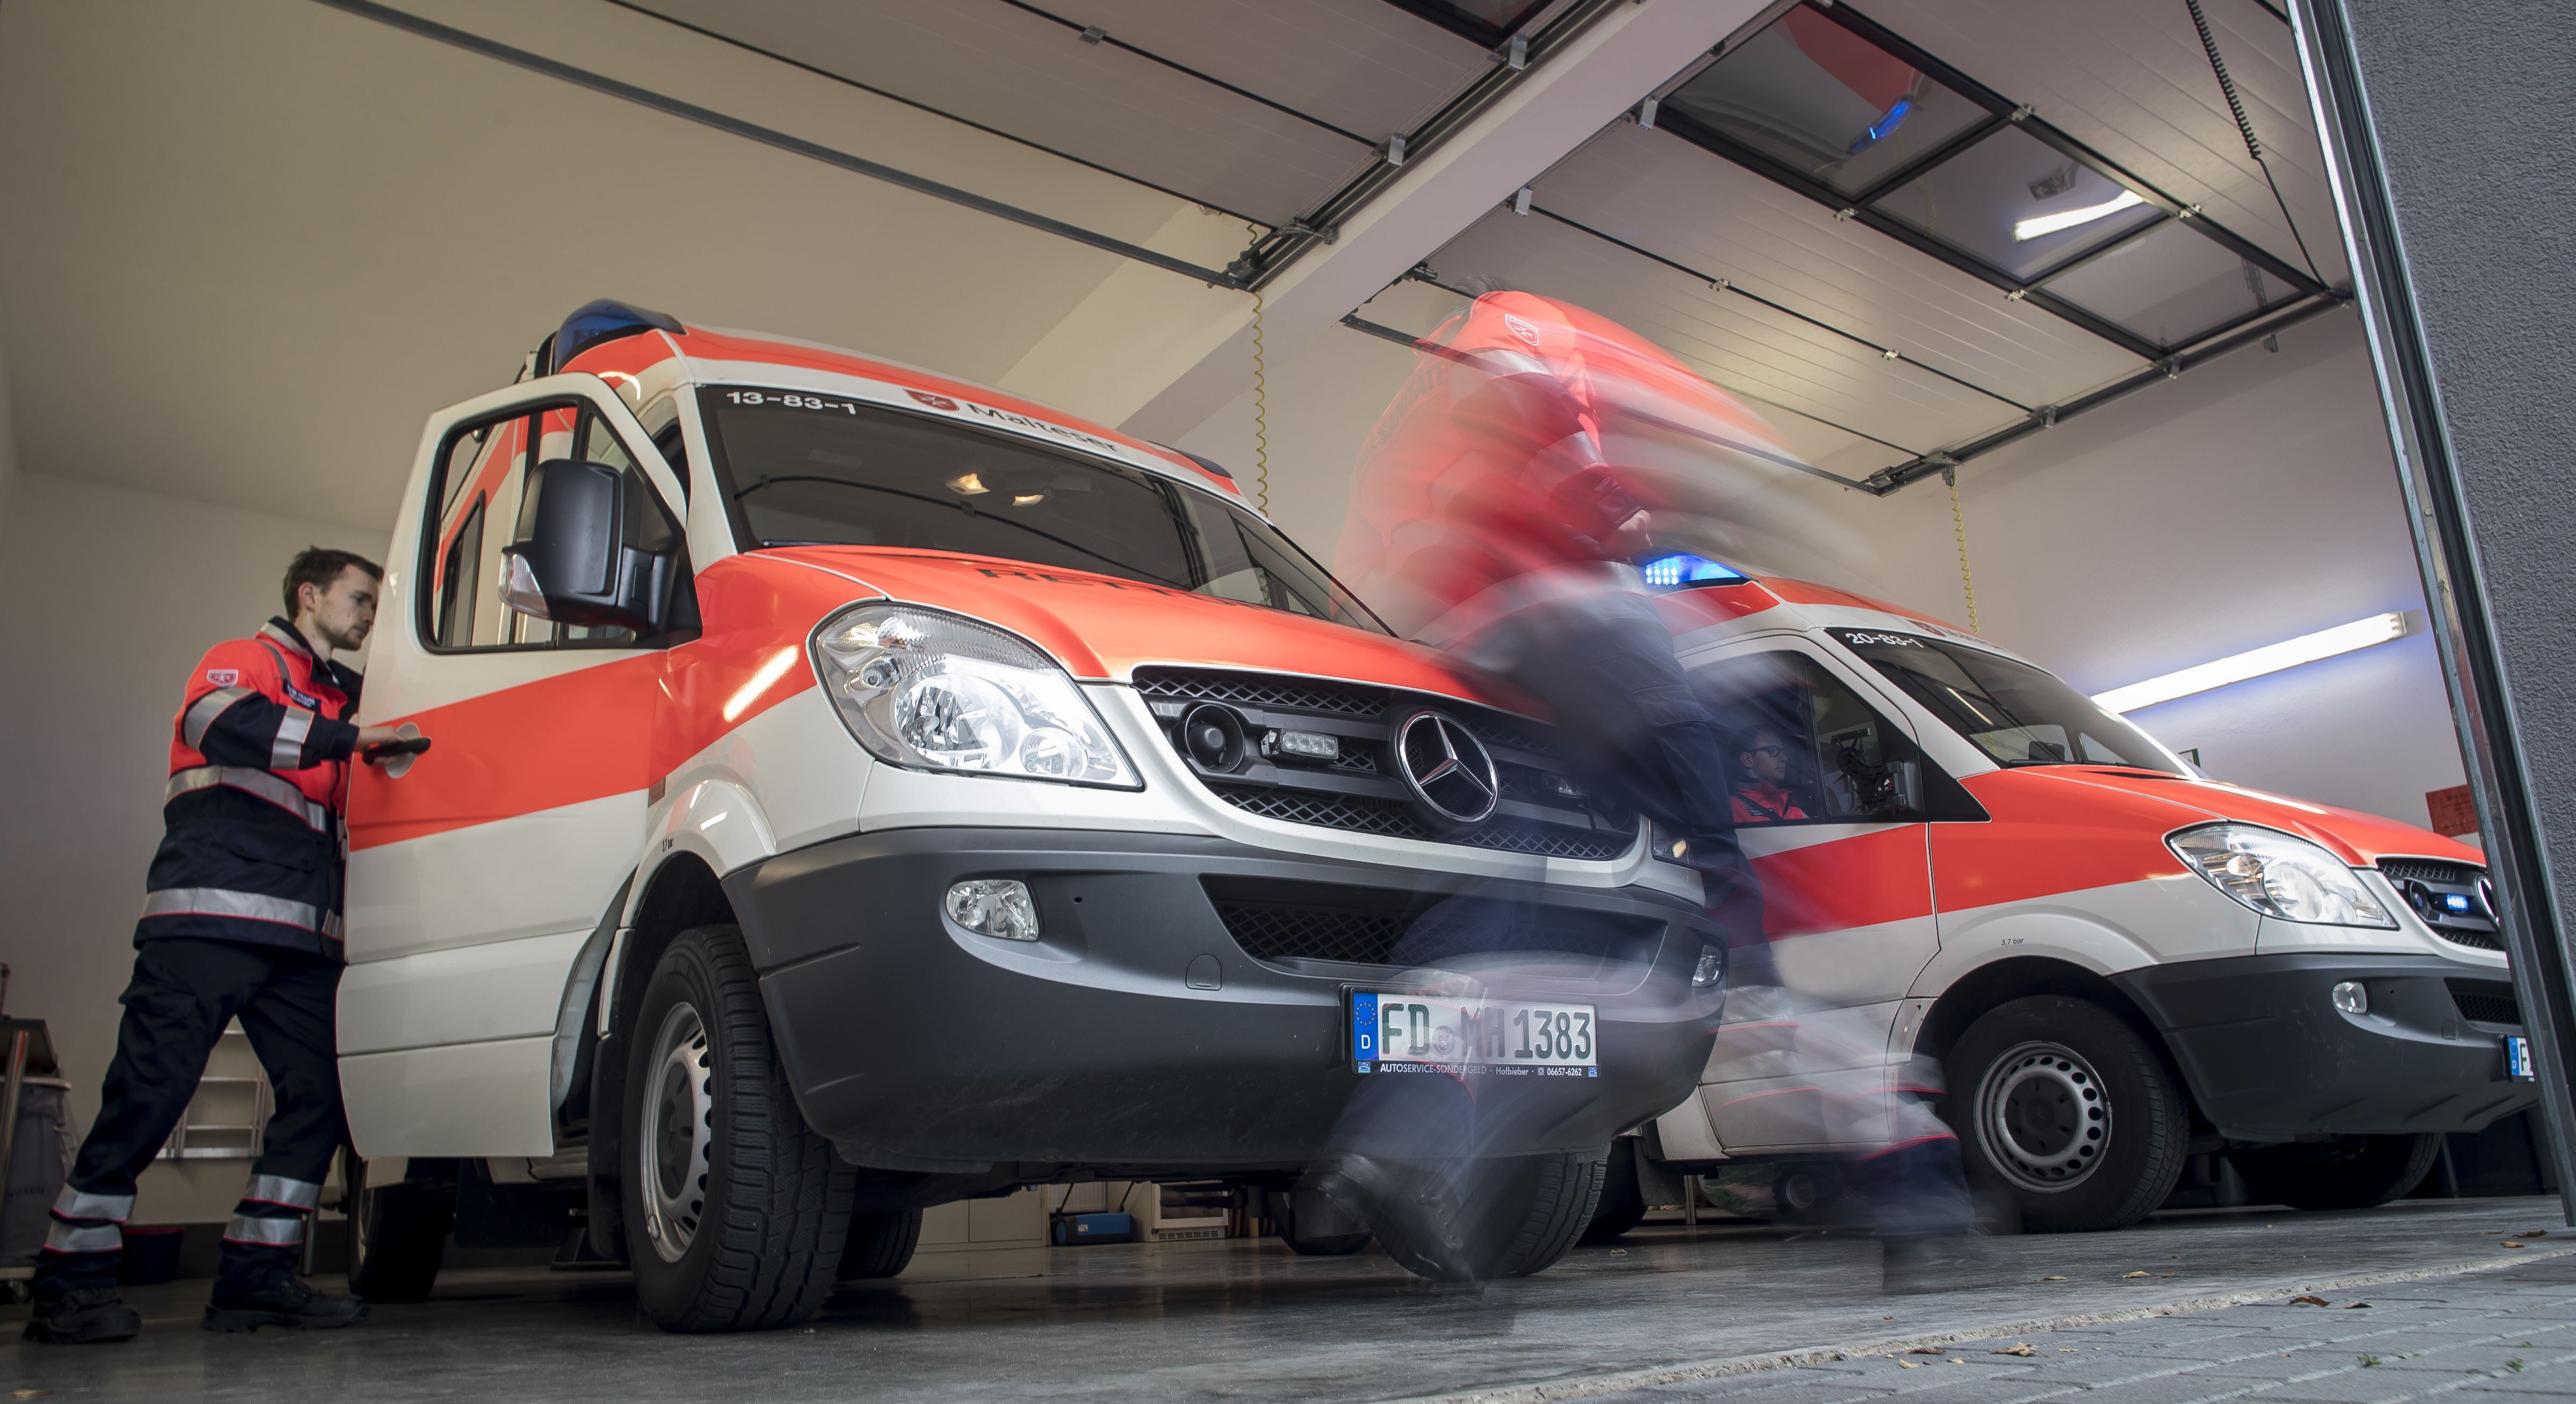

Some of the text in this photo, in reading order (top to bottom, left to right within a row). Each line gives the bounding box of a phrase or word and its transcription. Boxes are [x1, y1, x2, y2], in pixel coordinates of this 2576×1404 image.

[727, 391, 857, 415] 13-83-1
[967, 403, 1117, 453] Malteser
[1846, 633, 1924, 648] 20-83-1
[2001, 937, 2024, 946] 3,7 bar
[1381, 1002, 1430, 1055] FD
[1513, 1009, 1591, 1059] 1383
[1361, 1034, 1371, 1050] D
[1380, 1063, 1582, 1077] AUTOSERVICE-SONDERGELD Hofbieber 06657-6262
